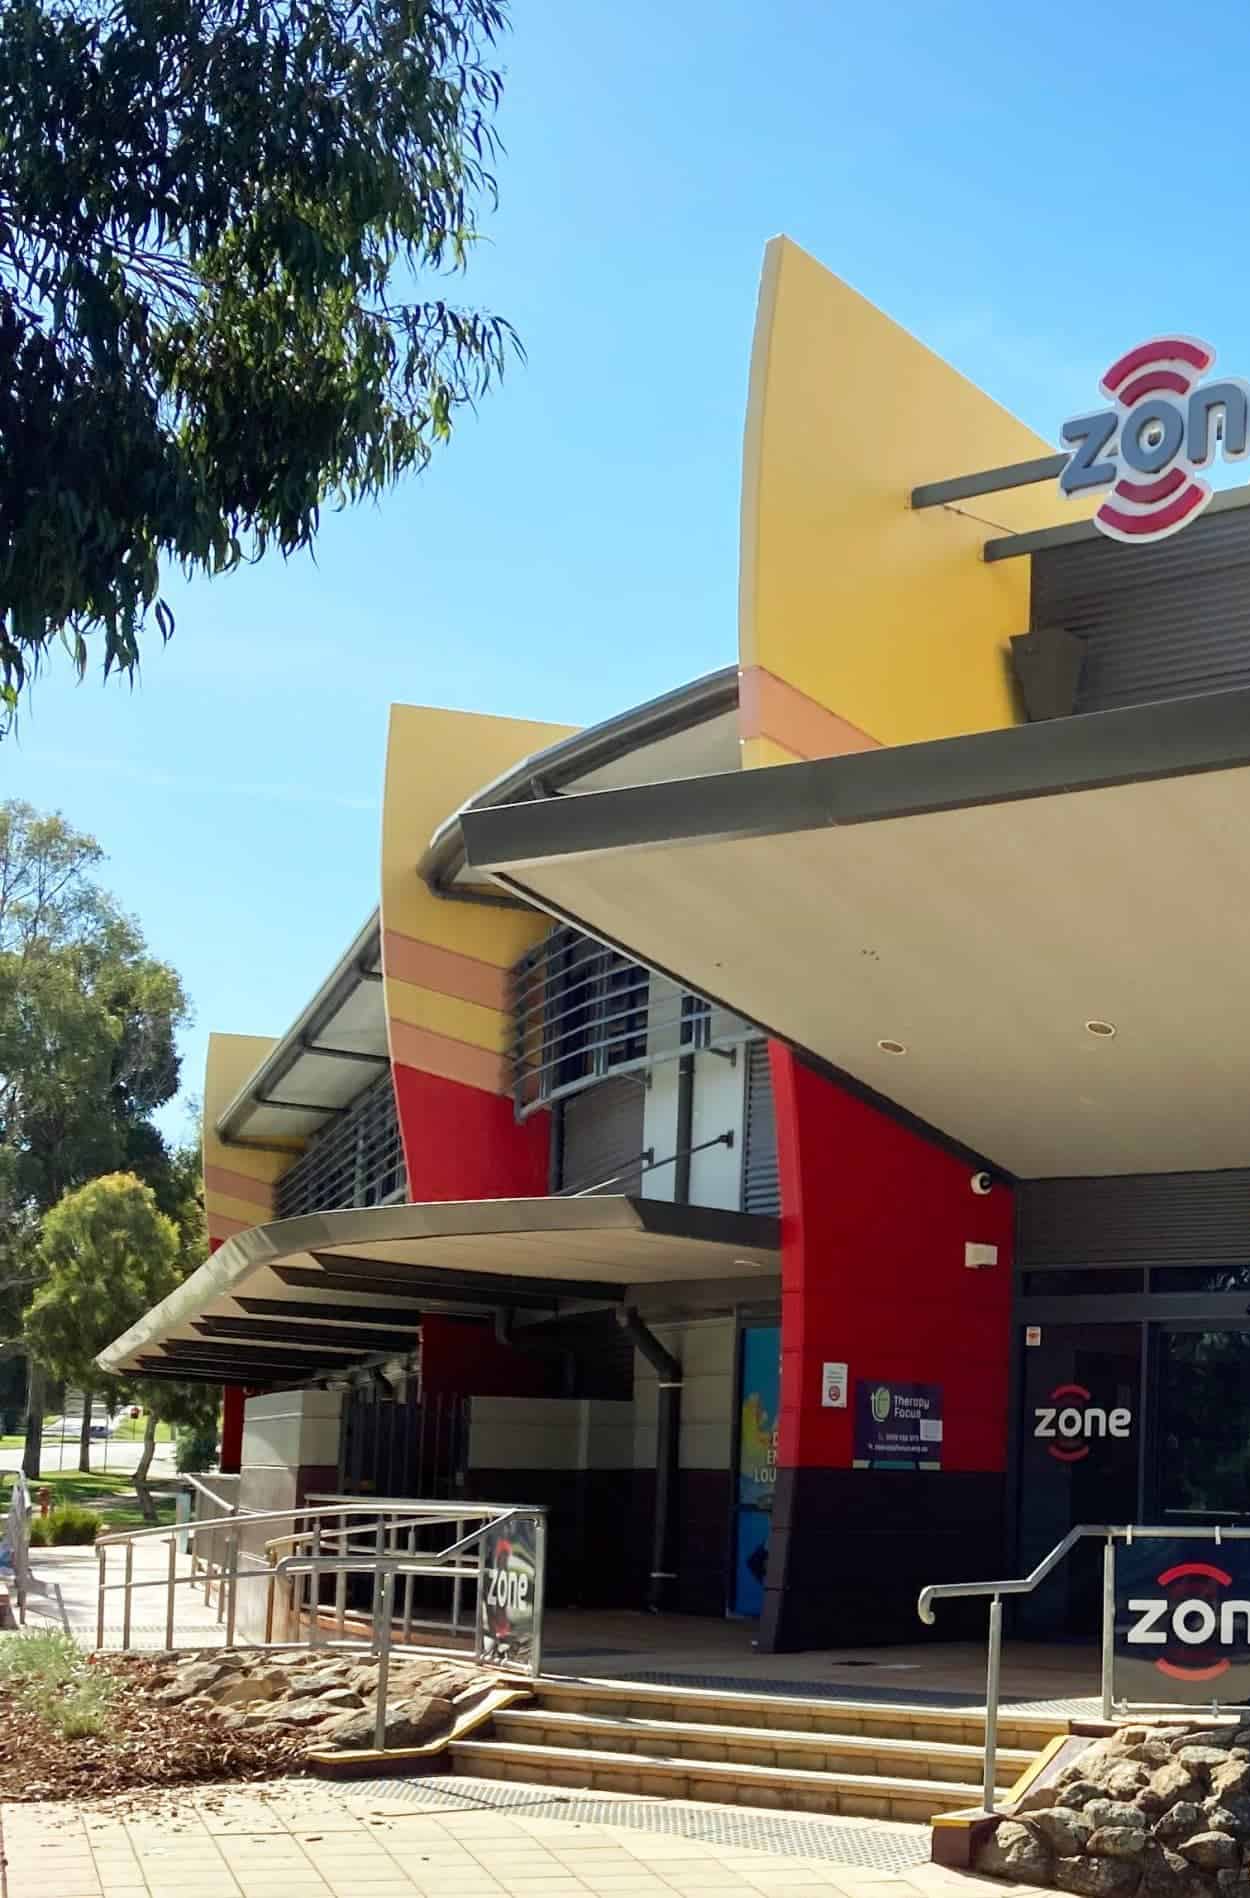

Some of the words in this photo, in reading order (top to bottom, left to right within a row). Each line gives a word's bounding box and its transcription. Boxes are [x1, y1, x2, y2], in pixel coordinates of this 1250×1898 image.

[894, 1395, 930, 1410] Therapy
[1034, 1407, 1132, 1439] zone
[487, 1568, 529, 1611] zone
